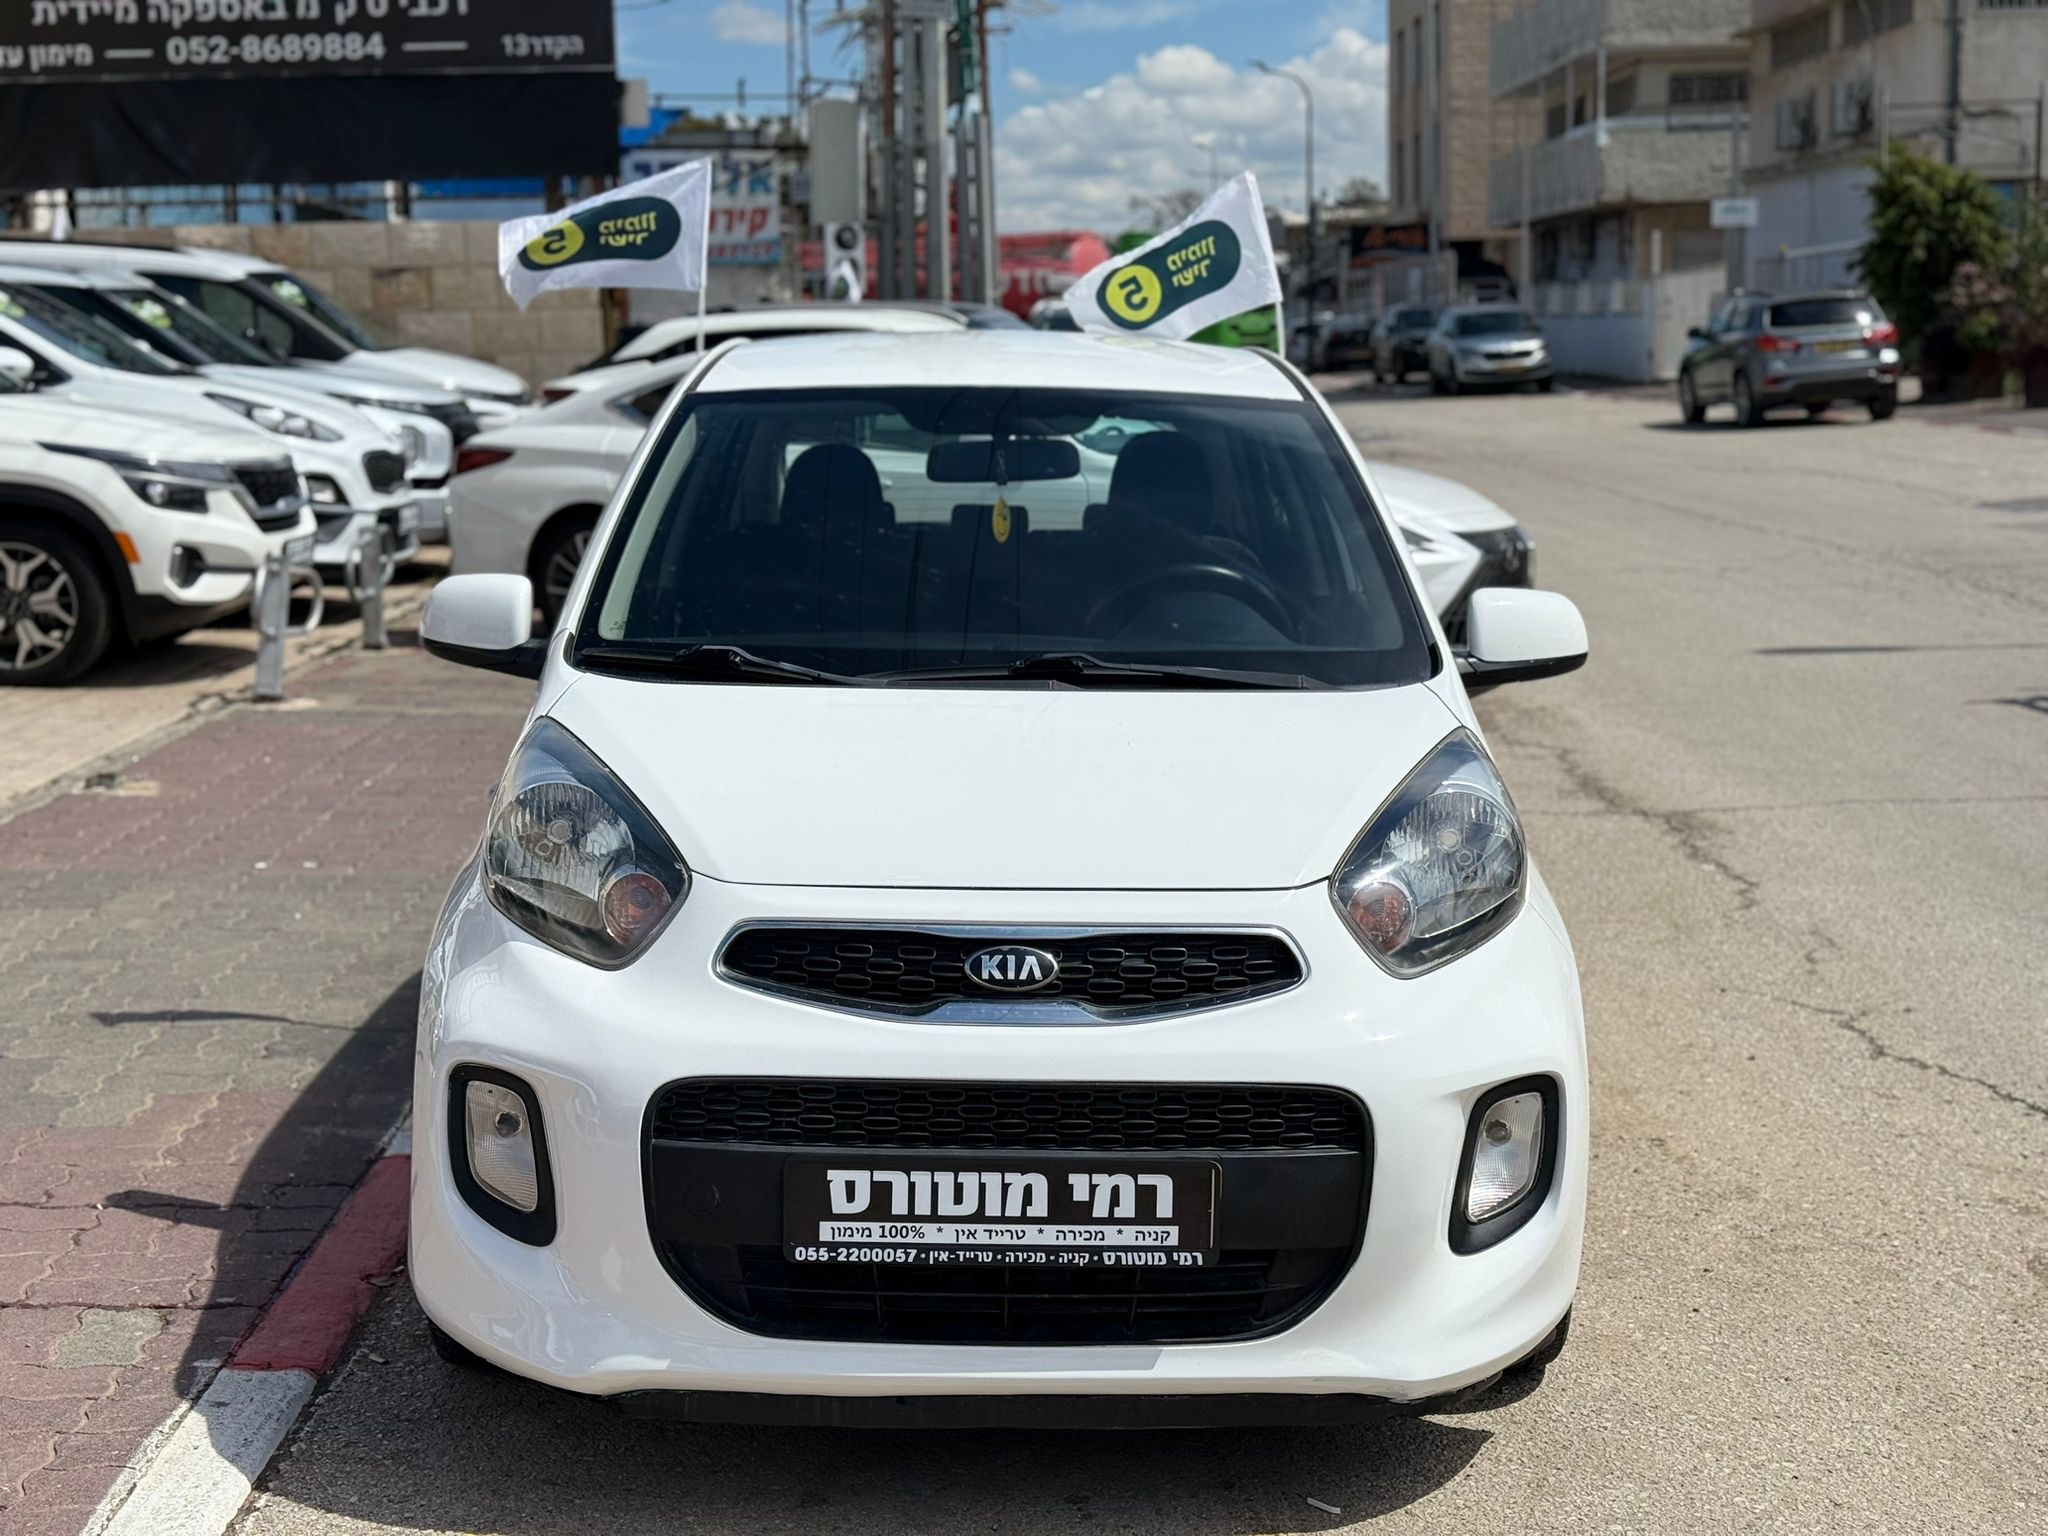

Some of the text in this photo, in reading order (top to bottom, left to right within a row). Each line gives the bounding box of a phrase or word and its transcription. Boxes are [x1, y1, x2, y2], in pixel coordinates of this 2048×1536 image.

[165, 31, 388, 65] 052-8689884
[28, 43, 94, 73] מימון
[981, 954, 1043, 980] KIA
[826, 1169, 1174, 1218] רמי מוטורס
[830, 1225, 1171, 1245] קניה מכירה טרייד אין 100% מימון
[794, 1246, 917, 1263] 055-2200057
[1005, 1251, 1047, 1264] מכירה
[1058, 1252, 1090, 1266] קניה
[1102, 1251, 1167, 1266] מוטורס
[1172, 1251, 1204, 1266] רמי
